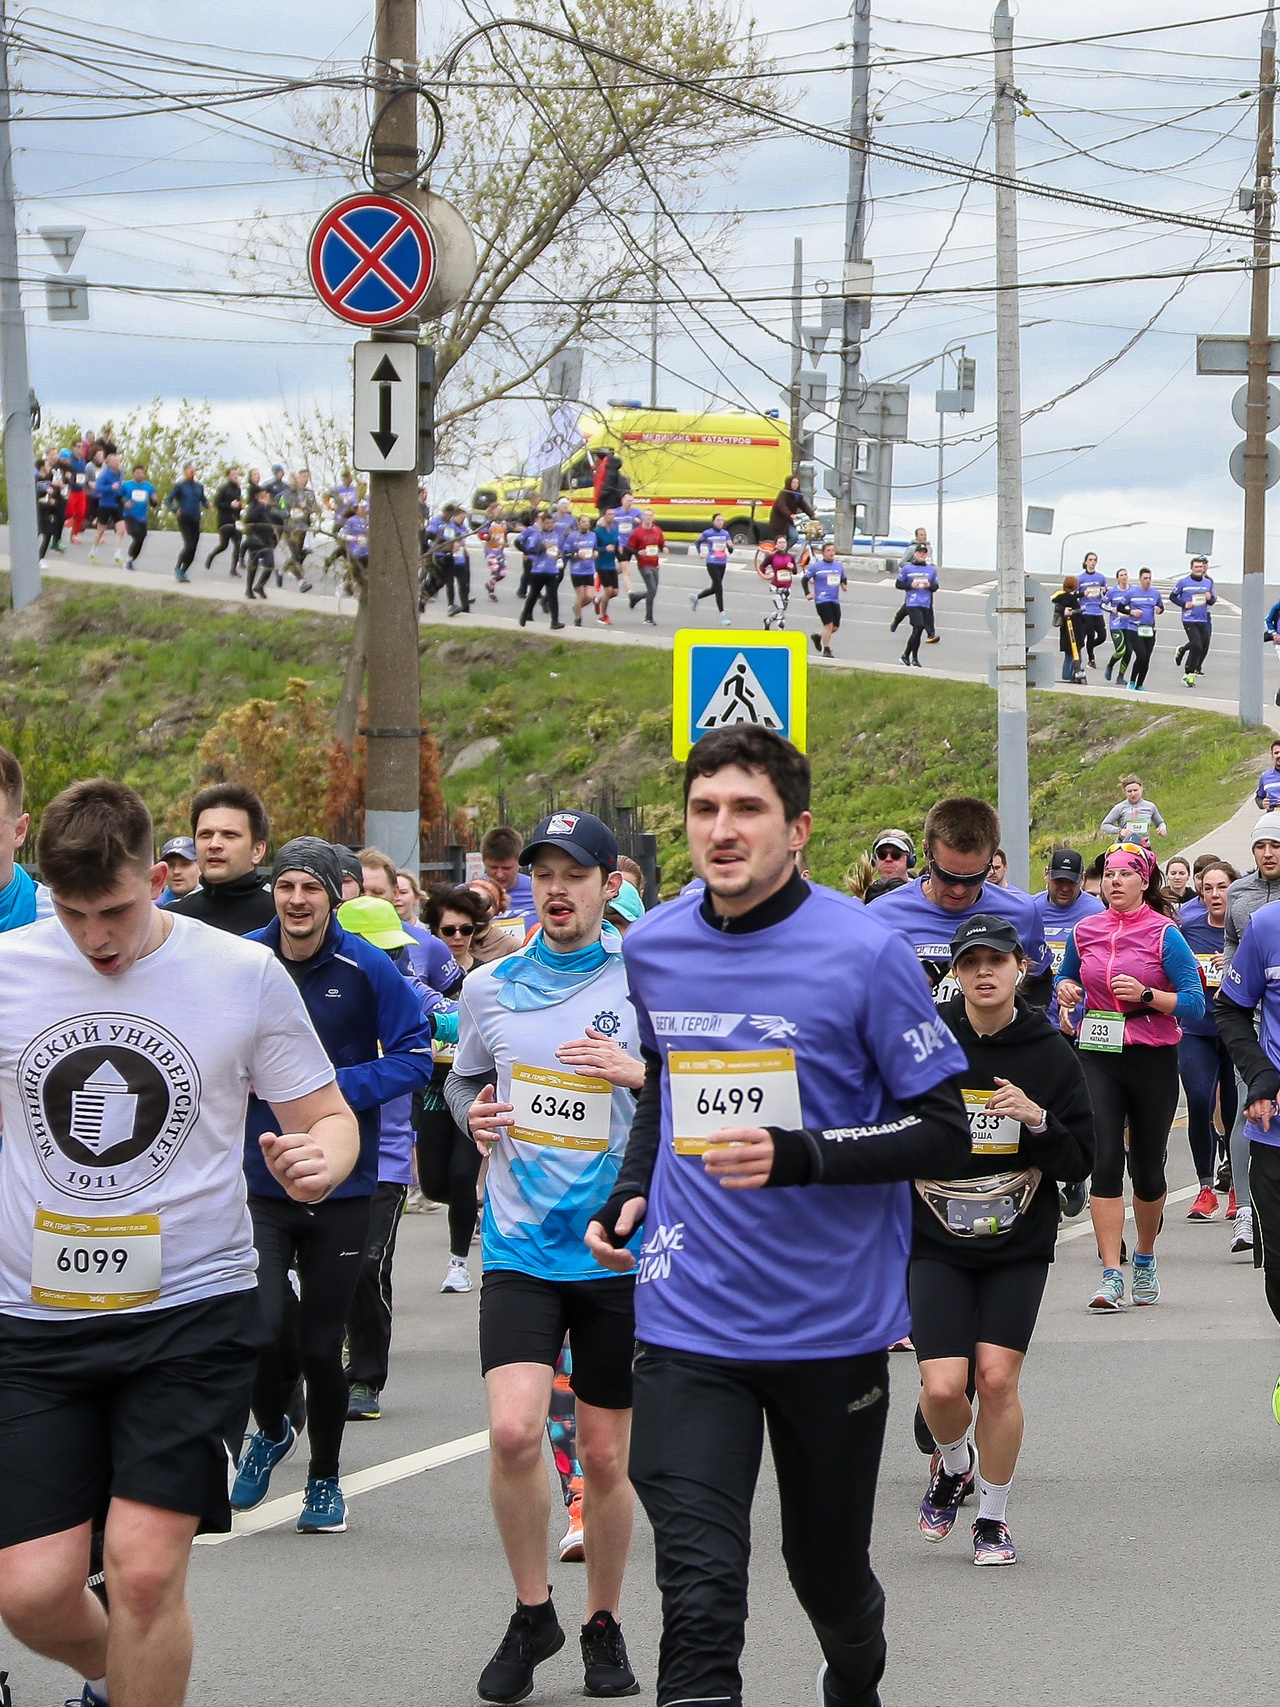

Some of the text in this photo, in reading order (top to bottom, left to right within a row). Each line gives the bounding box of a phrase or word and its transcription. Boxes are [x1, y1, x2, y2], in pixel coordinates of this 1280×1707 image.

[701, 436, 752, 445] КАТАСТРОФ
[656, 1015, 722, 1032] БЕГИ, ГЕРОЙ!
[1091, 1024, 1109, 1036] 233
[25, 1021, 191, 1169] МИНИНСКИЙ УНИВЕРСИТЕТ
[697, 1087, 764, 1114] 6499
[531, 1094, 586, 1121] 6348
[66, 1170, 119, 1189] 1911
[57, 1247, 128, 1273] 6099
